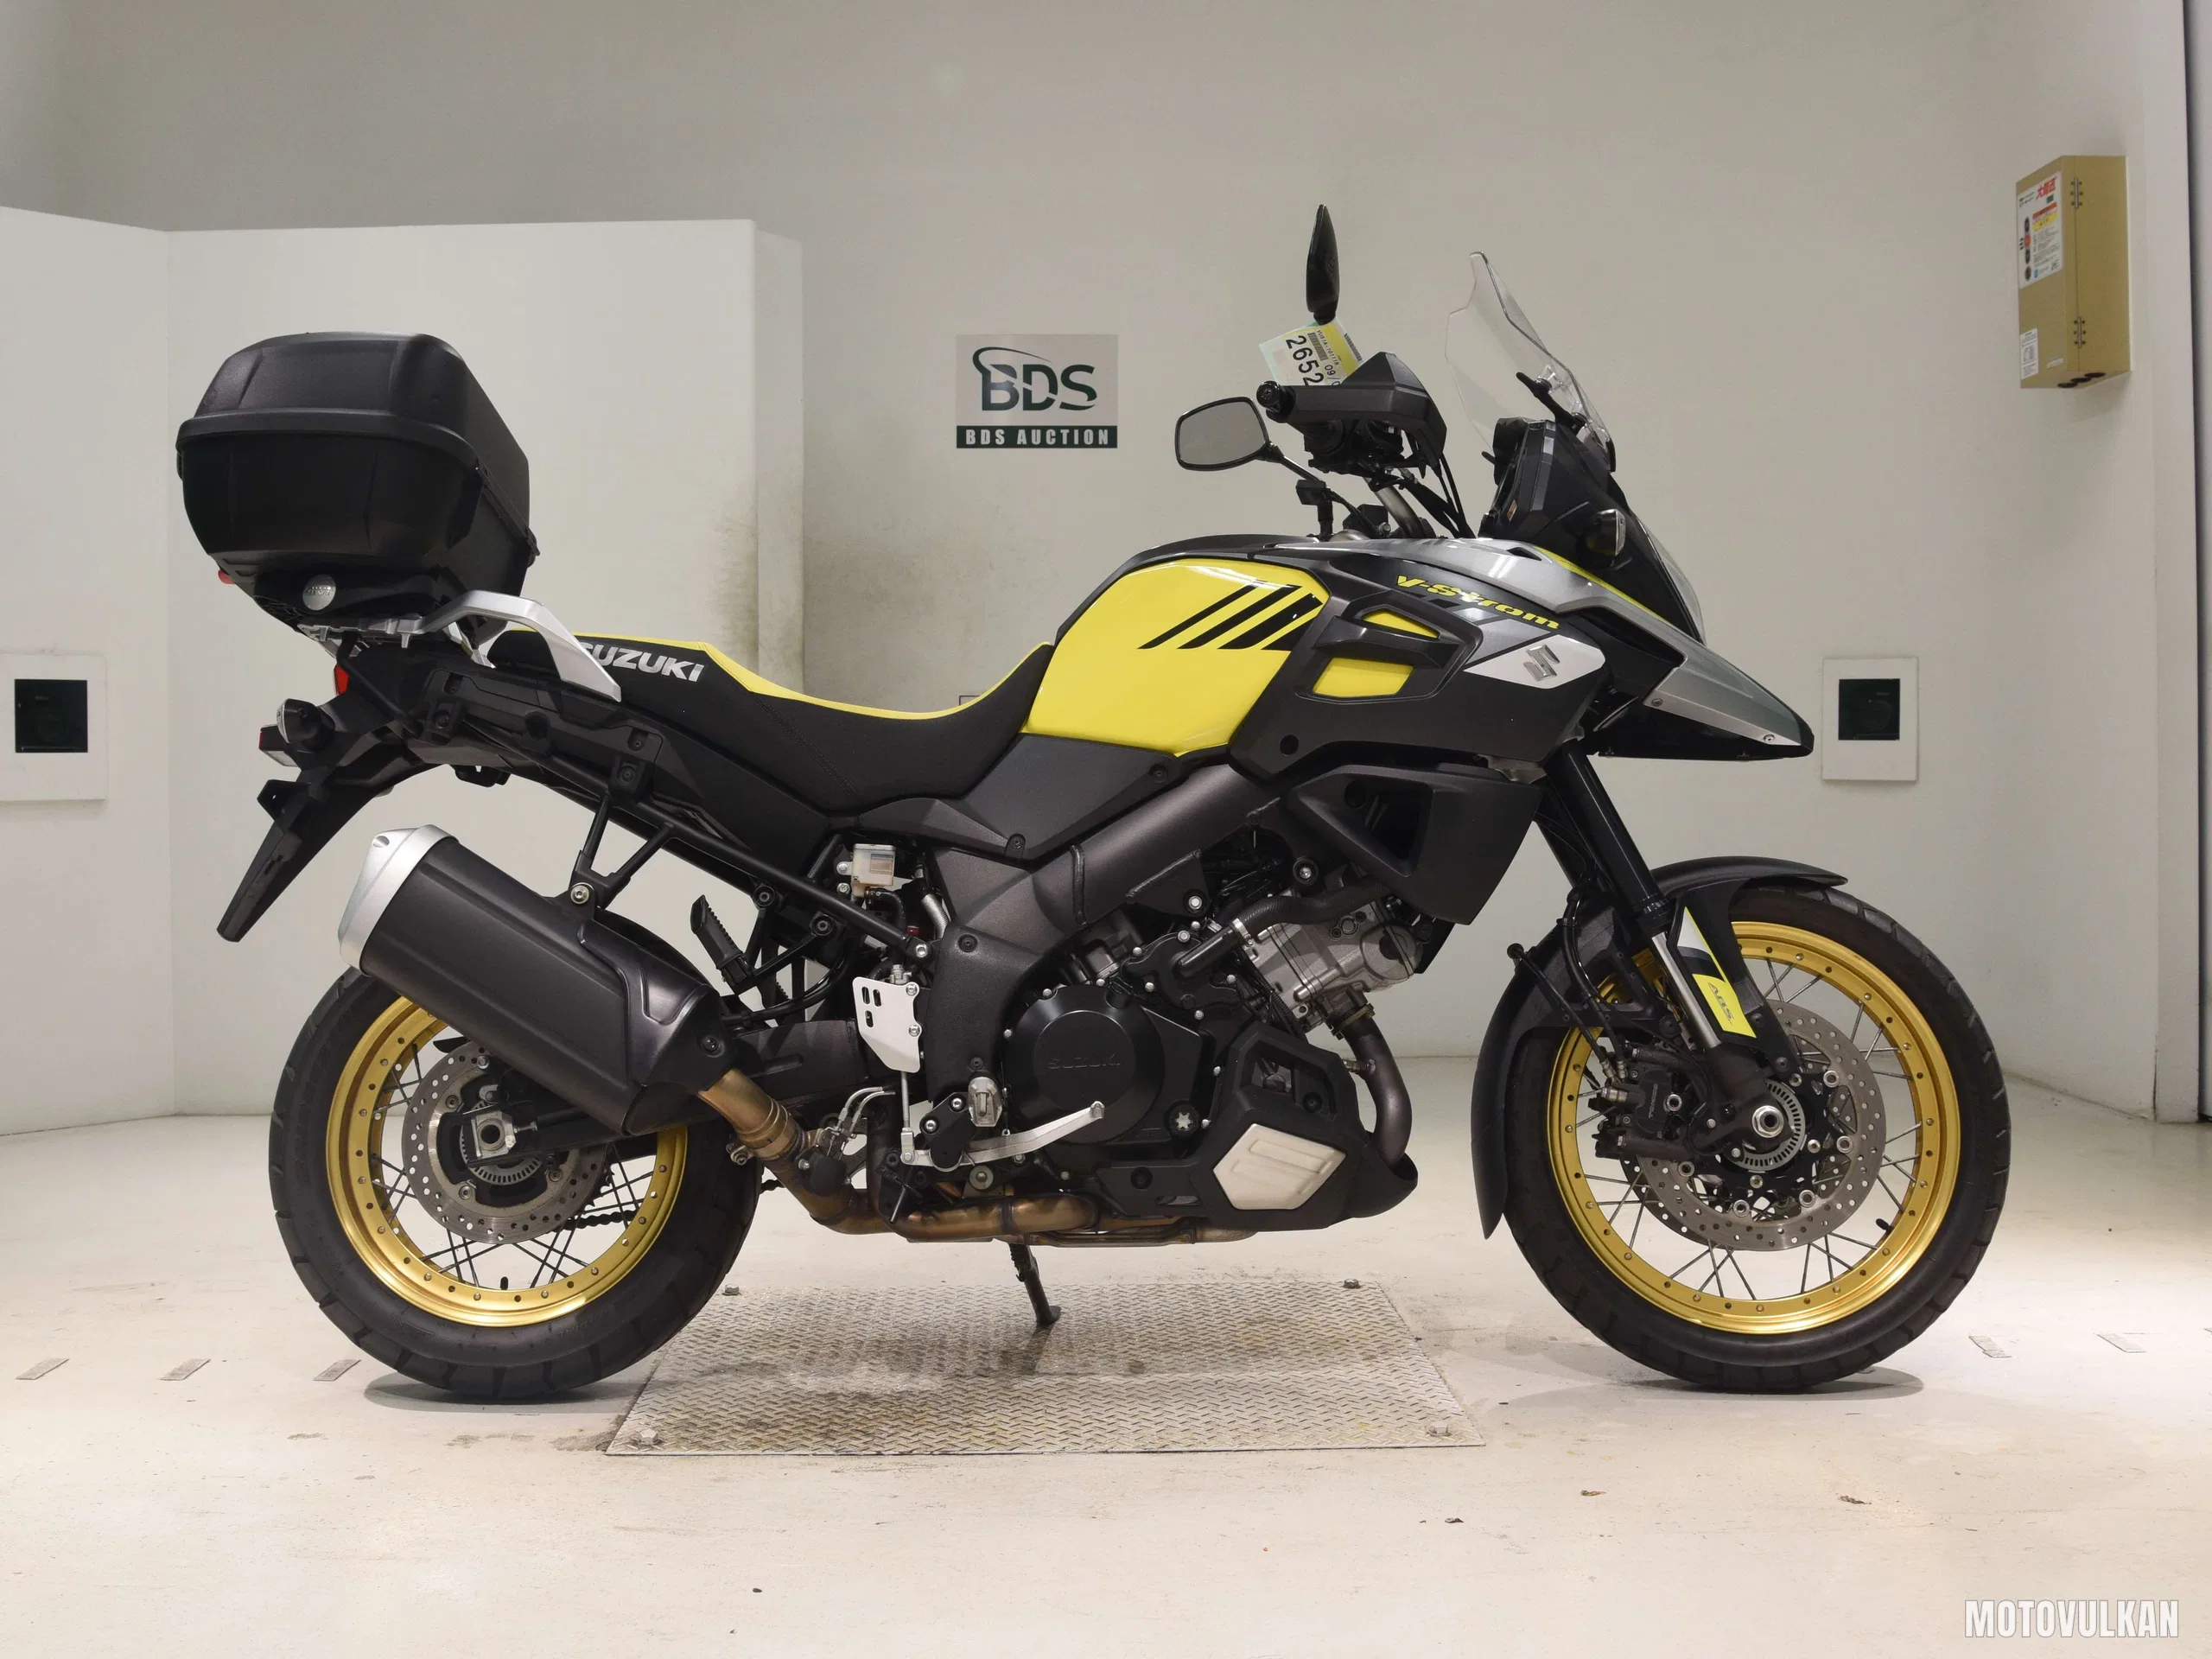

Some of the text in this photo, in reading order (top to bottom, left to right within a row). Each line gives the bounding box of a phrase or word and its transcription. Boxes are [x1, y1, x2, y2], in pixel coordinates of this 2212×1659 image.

[973, 346, 1097, 411] BDS
[1286, 335, 1324, 386] 2652
[965, 429, 1109, 445] BDS AUCTION
